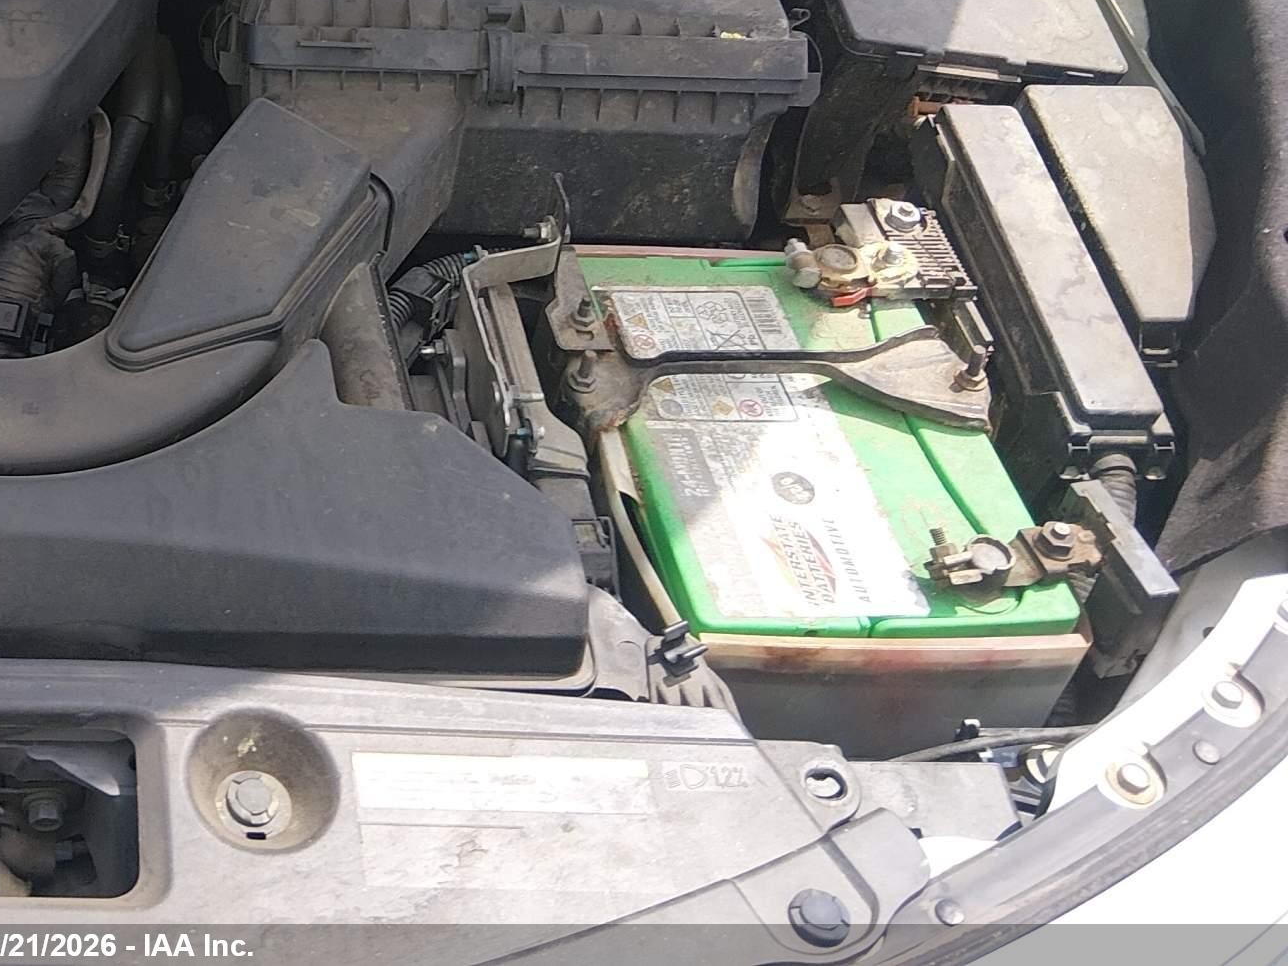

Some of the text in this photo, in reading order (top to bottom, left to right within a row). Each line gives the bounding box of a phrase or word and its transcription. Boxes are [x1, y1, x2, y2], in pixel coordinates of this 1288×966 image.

[769, 515, 820, 607] INTERSTATE
[788, 522, 836, 604] BATTERIES
[822, 518, 872, 602] AUTOMOTIVE
